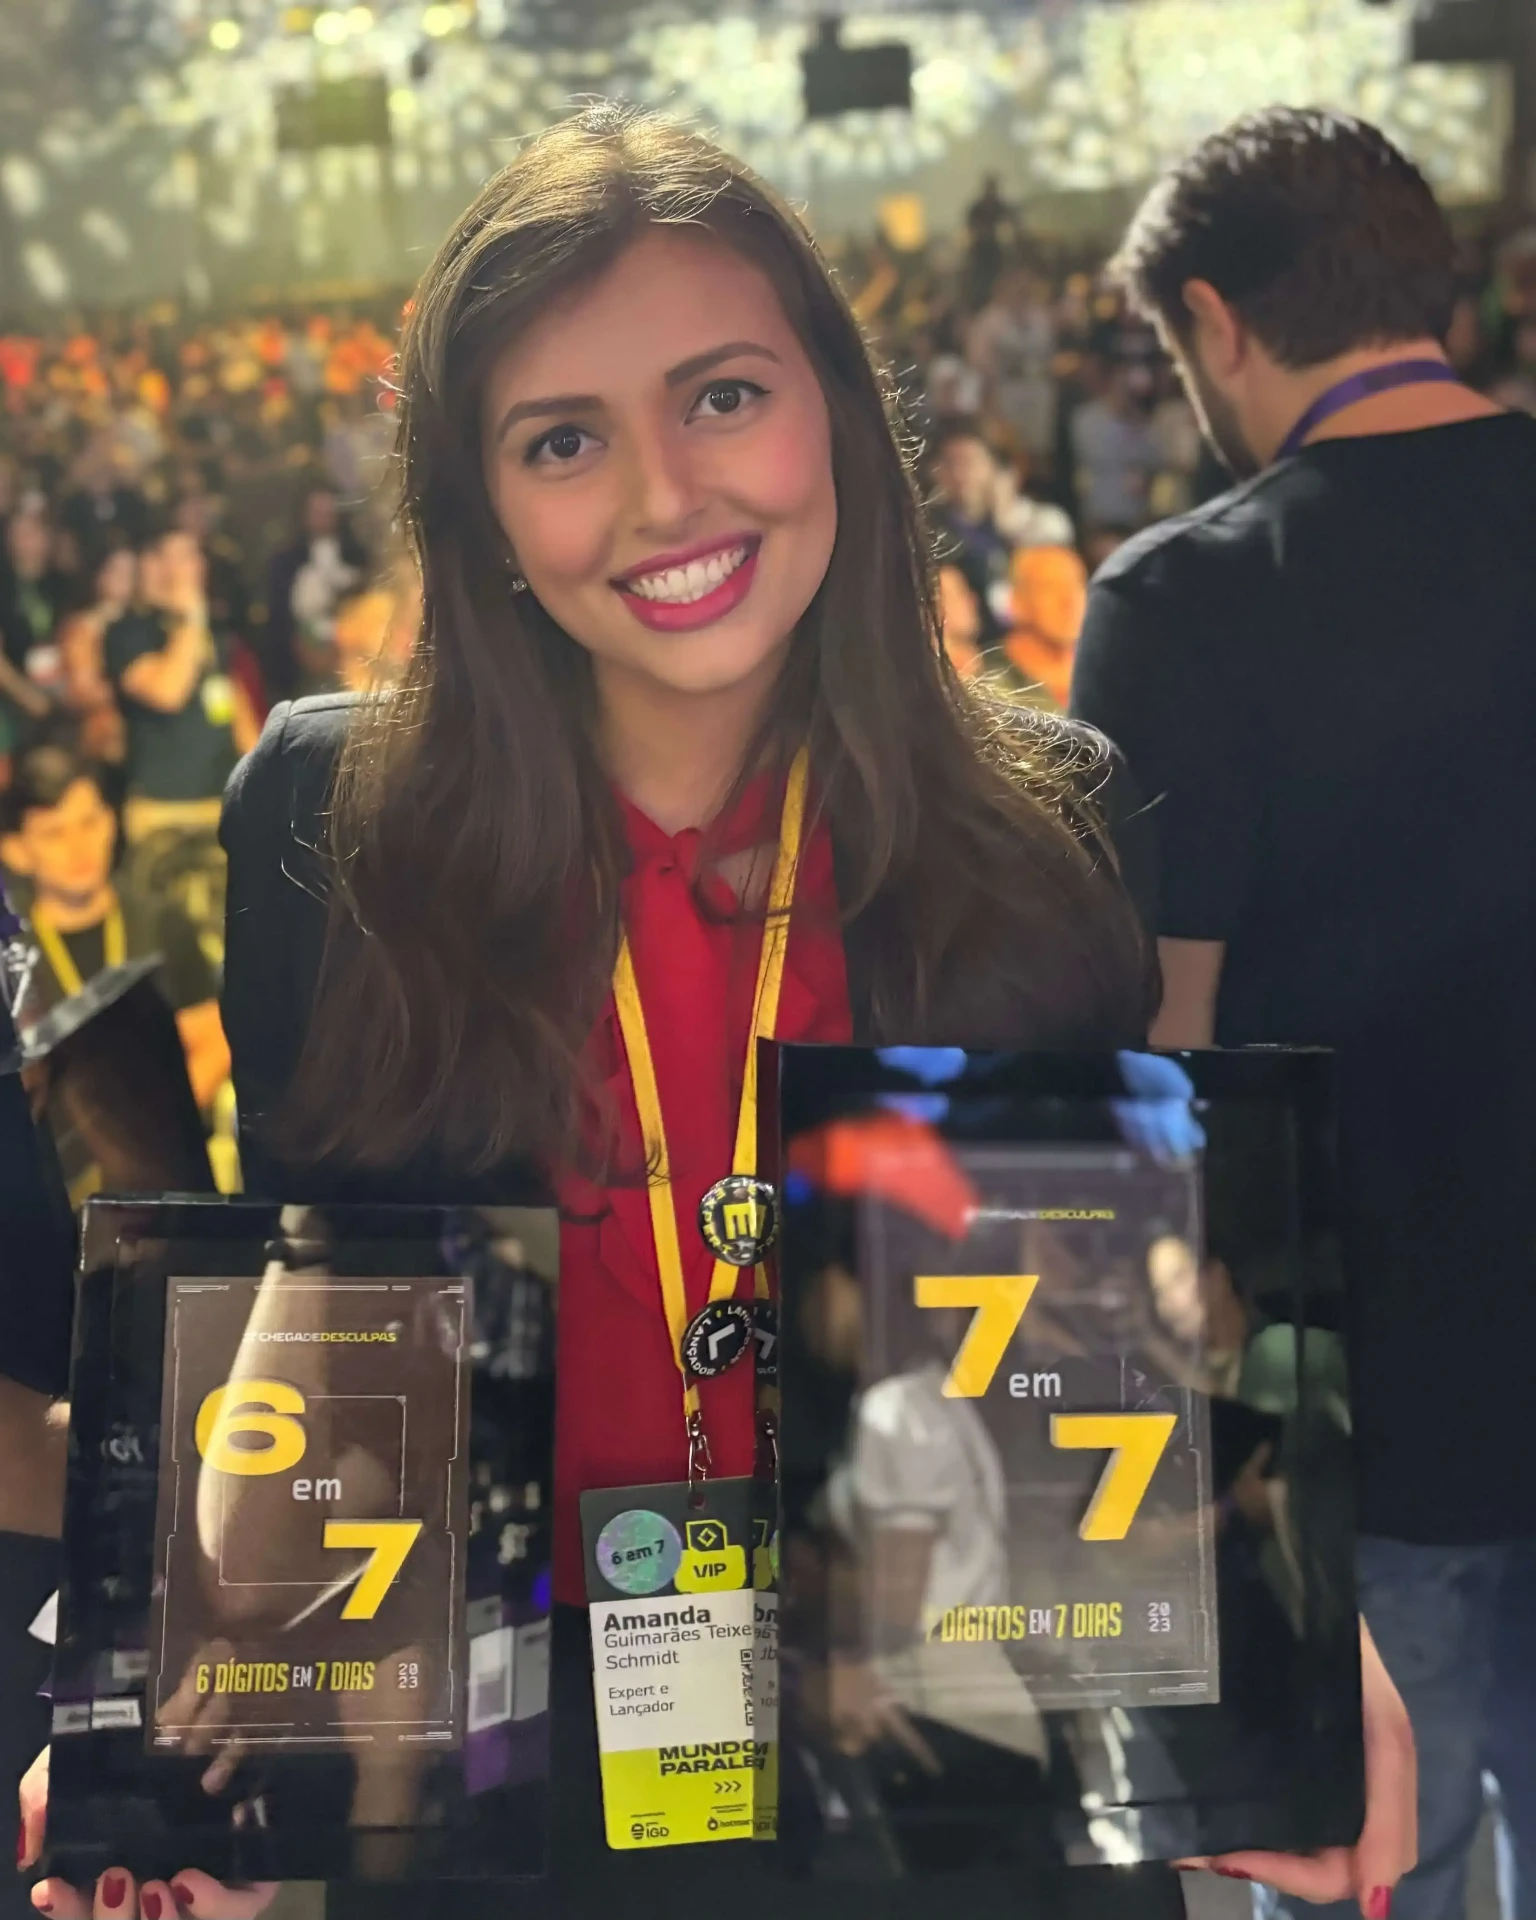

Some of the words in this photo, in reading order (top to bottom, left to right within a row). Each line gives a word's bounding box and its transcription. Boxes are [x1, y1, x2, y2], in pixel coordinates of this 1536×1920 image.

[914, 1274, 1039, 1398] 7
[1008, 1372, 1062, 1398] em
[195, 1379, 306, 1476] 6
[1050, 1412, 1178, 1541] 7
[292, 1478, 341, 1501] em
[611, 1551, 622, 1565] 6
[626, 1546, 653, 1561] em
[655, 1539, 665, 1553] 7
[322, 1519, 423, 1620] 7
[694, 1563, 727, 1578] VIP
[604, 1605, 711, 1632] Amanda
[1029, 1609, 1050, 1635] EM
[1054, 1604, 1068, 1638] 7
[1072, 1602, 1123, 1638] DIAS
[1148, 1602, 1171, 1616] 20
[605, 1627, 701, 1648] Guimarães
[705, 1623, 752, 1640] Teixe
[1149, 1617, 1171, 1632] 23
[398, 1663, 418, 1675] 20
[606, 1650, 680, 1670] Schmidt
[196, 1664, 210, 1693] 6
[214, 1657, 289, 1693] DÍGITOS
[292, 1666, 313, 1688] EM
[315, 1662, 327, 1691] 7
[330, 1661, 375, 1691] DIAS
[398, 1676, 418, 1689] 23
[608, 1685, 655, 1700] Expert
[660, 1685, 669, 1695] e
[609, 1701, 675, 1717] Lançador
